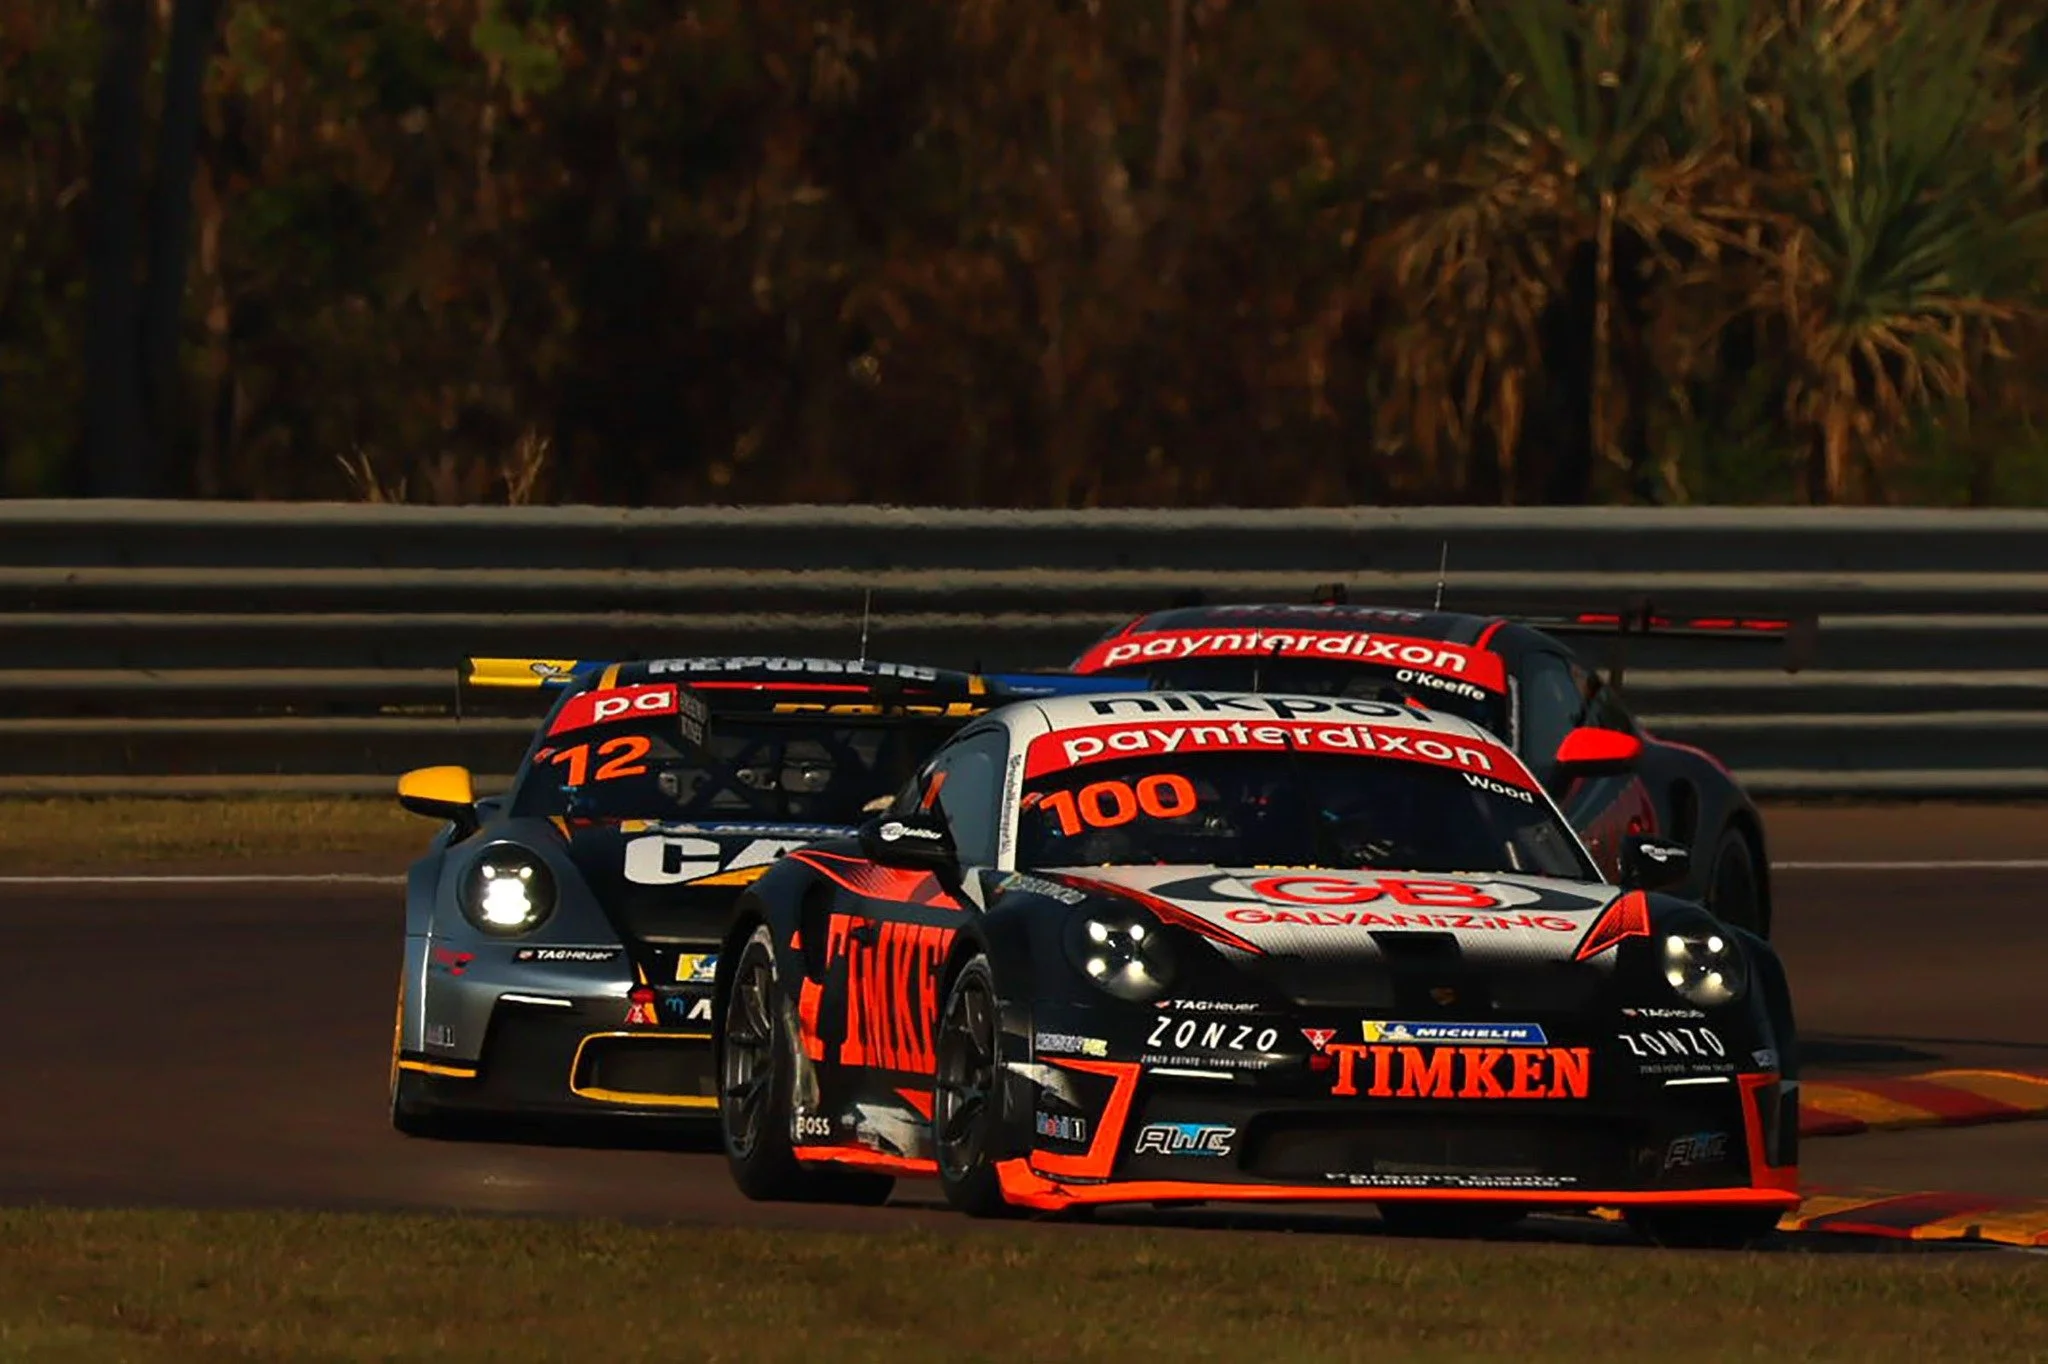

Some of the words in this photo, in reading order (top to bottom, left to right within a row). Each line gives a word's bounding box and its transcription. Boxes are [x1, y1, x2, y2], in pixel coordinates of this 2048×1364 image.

[1103, 629, 1468, 672] paynterdixon
[1395, 669, 1485, 701] O'Keeffe
[594, 689, 672, 722] pa
[551, 736, 651, 787] 12
[1064, 721, 1493, 770] paynterdixon
[1463, 772, 1534, 804] Wood
[1039, 774, 1198, 837] 100
[1252, 877, 1500, 908] GB
[1147, 1016, 1278, 1052] ZONZO
[1416, 1026, 1528, 1039] MICHELIN
[1618, 1027, 1726, 1057] ZONZO
[1325, 1043, 1591, 1098] TIMKEN
